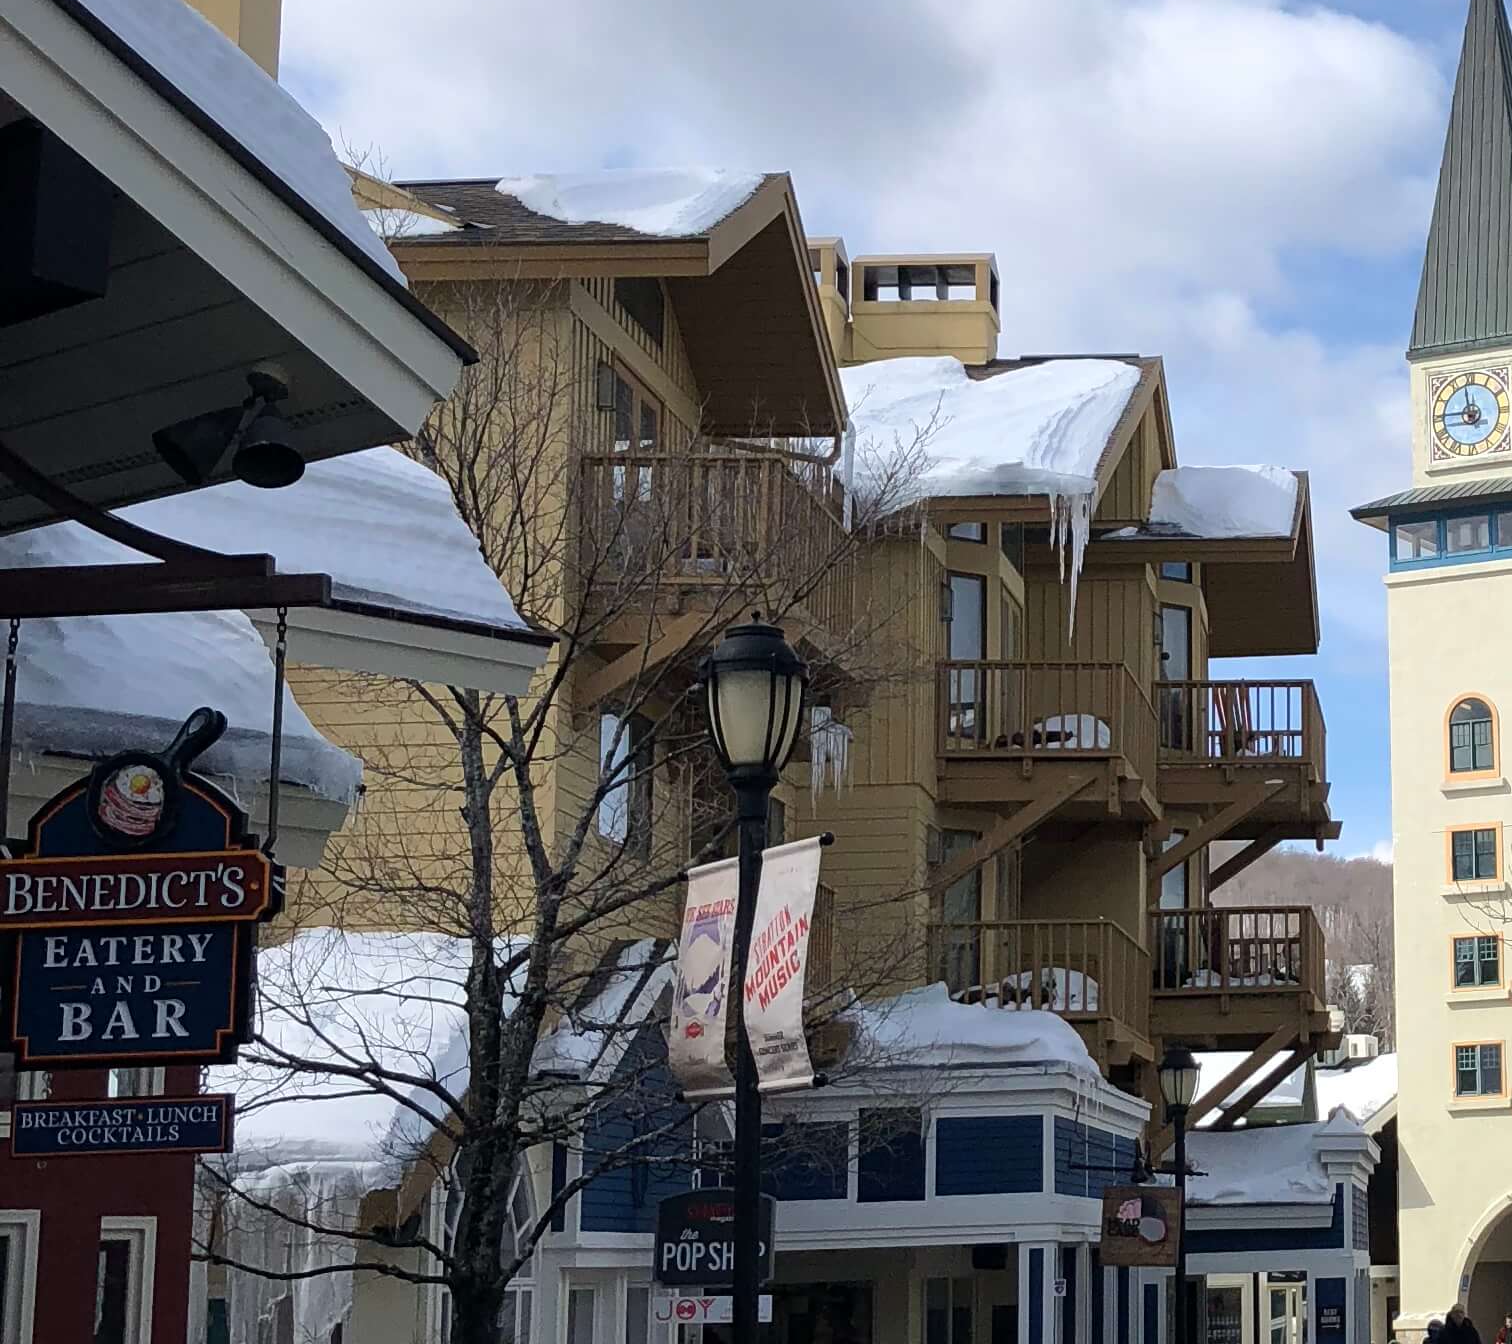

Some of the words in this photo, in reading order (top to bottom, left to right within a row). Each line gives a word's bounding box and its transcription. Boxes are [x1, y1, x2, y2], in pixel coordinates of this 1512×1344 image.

[3, 863, 245, 915] BENEDICT'S
[43, 933, 215, 968] EATERY
[754, 904, 791, 964] STRATTON
[745, 913, 808, 1002] MOUNTAIN
[91, 975, 162, 995] AND
[759, 950, 800, 1013] MUSIC
[58, 999, 190, 1042] BAR
[21, 1109, 136, 1129] BREAKFAST
[146, 1105, 218, 1124] LUNCH
[57, 1125, 180, 1145] COCKTAILS
[680, 1228, 699, 1240] the
